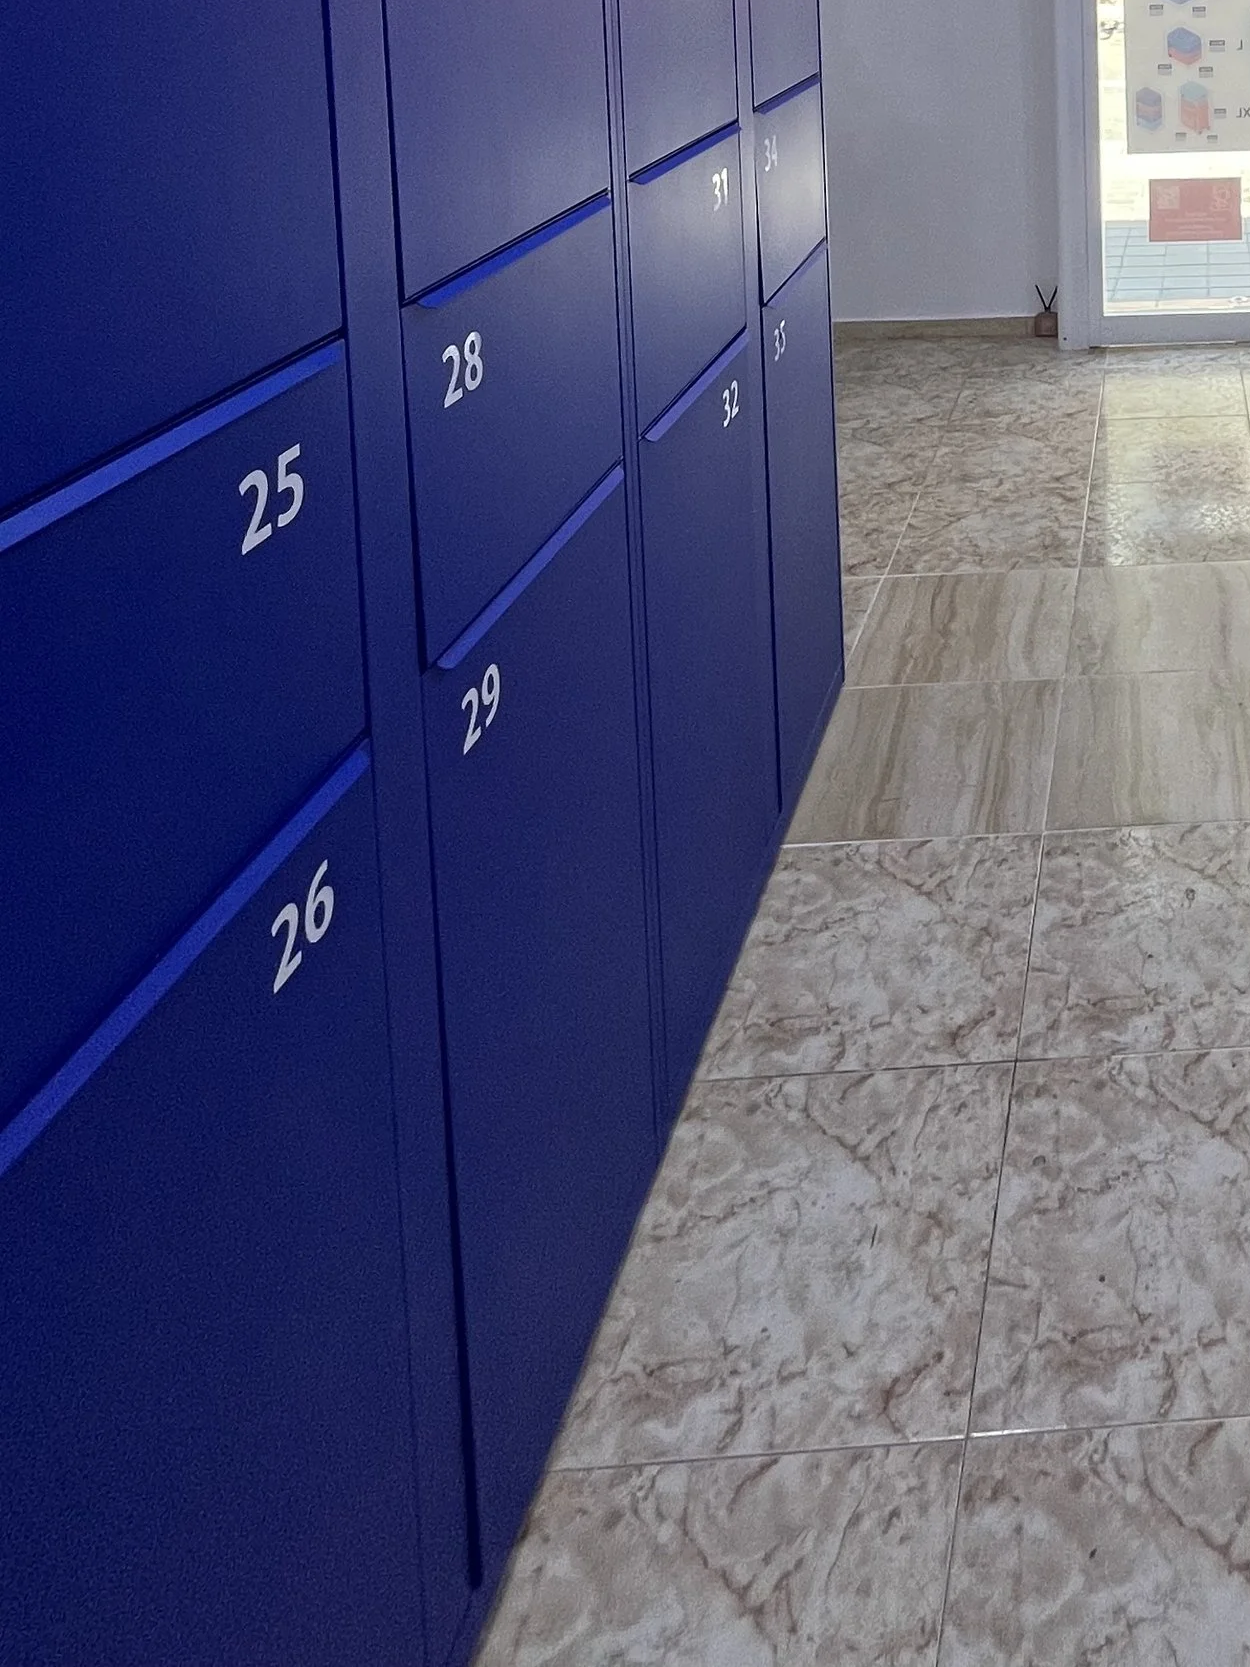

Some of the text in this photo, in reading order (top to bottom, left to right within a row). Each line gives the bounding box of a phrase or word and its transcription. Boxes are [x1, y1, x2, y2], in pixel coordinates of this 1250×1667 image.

[764, 135, 778, 173] 34
[712, 167, 728, 210] 31
[441, 331, 483, 409] 28
[772, 319, 787, 361] 35
[722, 380, 740, 428] 32
[238, 443, 304, 556] 25
[461, 663, 500, 756] 29
[271, 859, 334, 994] 26
